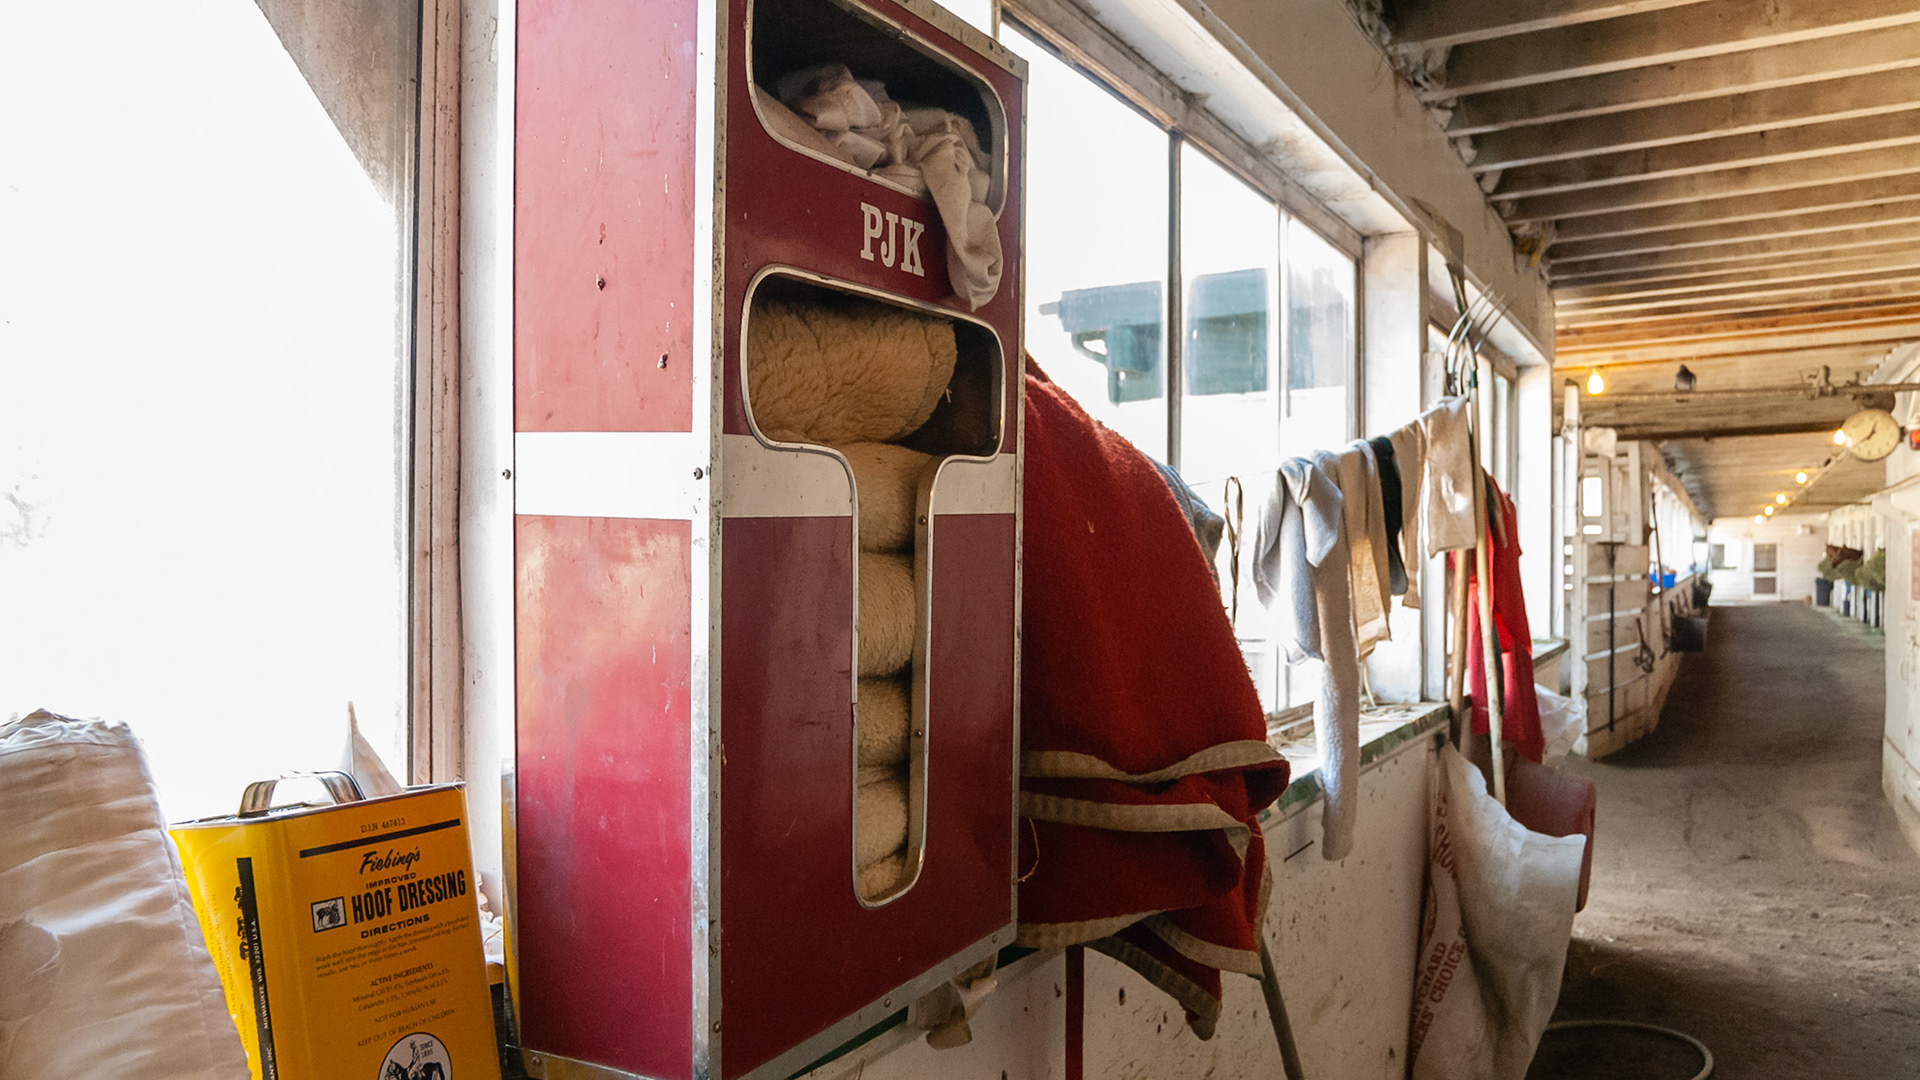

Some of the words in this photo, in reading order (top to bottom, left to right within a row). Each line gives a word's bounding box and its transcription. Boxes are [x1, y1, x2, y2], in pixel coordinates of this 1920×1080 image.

[861, 201, 925, 277] PJK
[359, 846, 421, 875] Fiebing's
[366, 872, 417, 890] IMPROVED
[351, 887, 393, 924] HOOF
[397, 869, 466, 912] DRESSING
[250, 918, 259, 941] U.S.A.
[361, 914, 430, 939] DIRECTIONS
[370, 975, 391, 987] ACTIVE
[393, 962, 434, 980] INGREDIENTS
[1430, 941, 1466, 1003] CHOICE
[375, 1014, 388, 1024] NOT
[389, 1010, 401, 1019] FOR
[357, 1037, 372, 1047] KEEP
[373, 1031, 387, 1042] OUT
